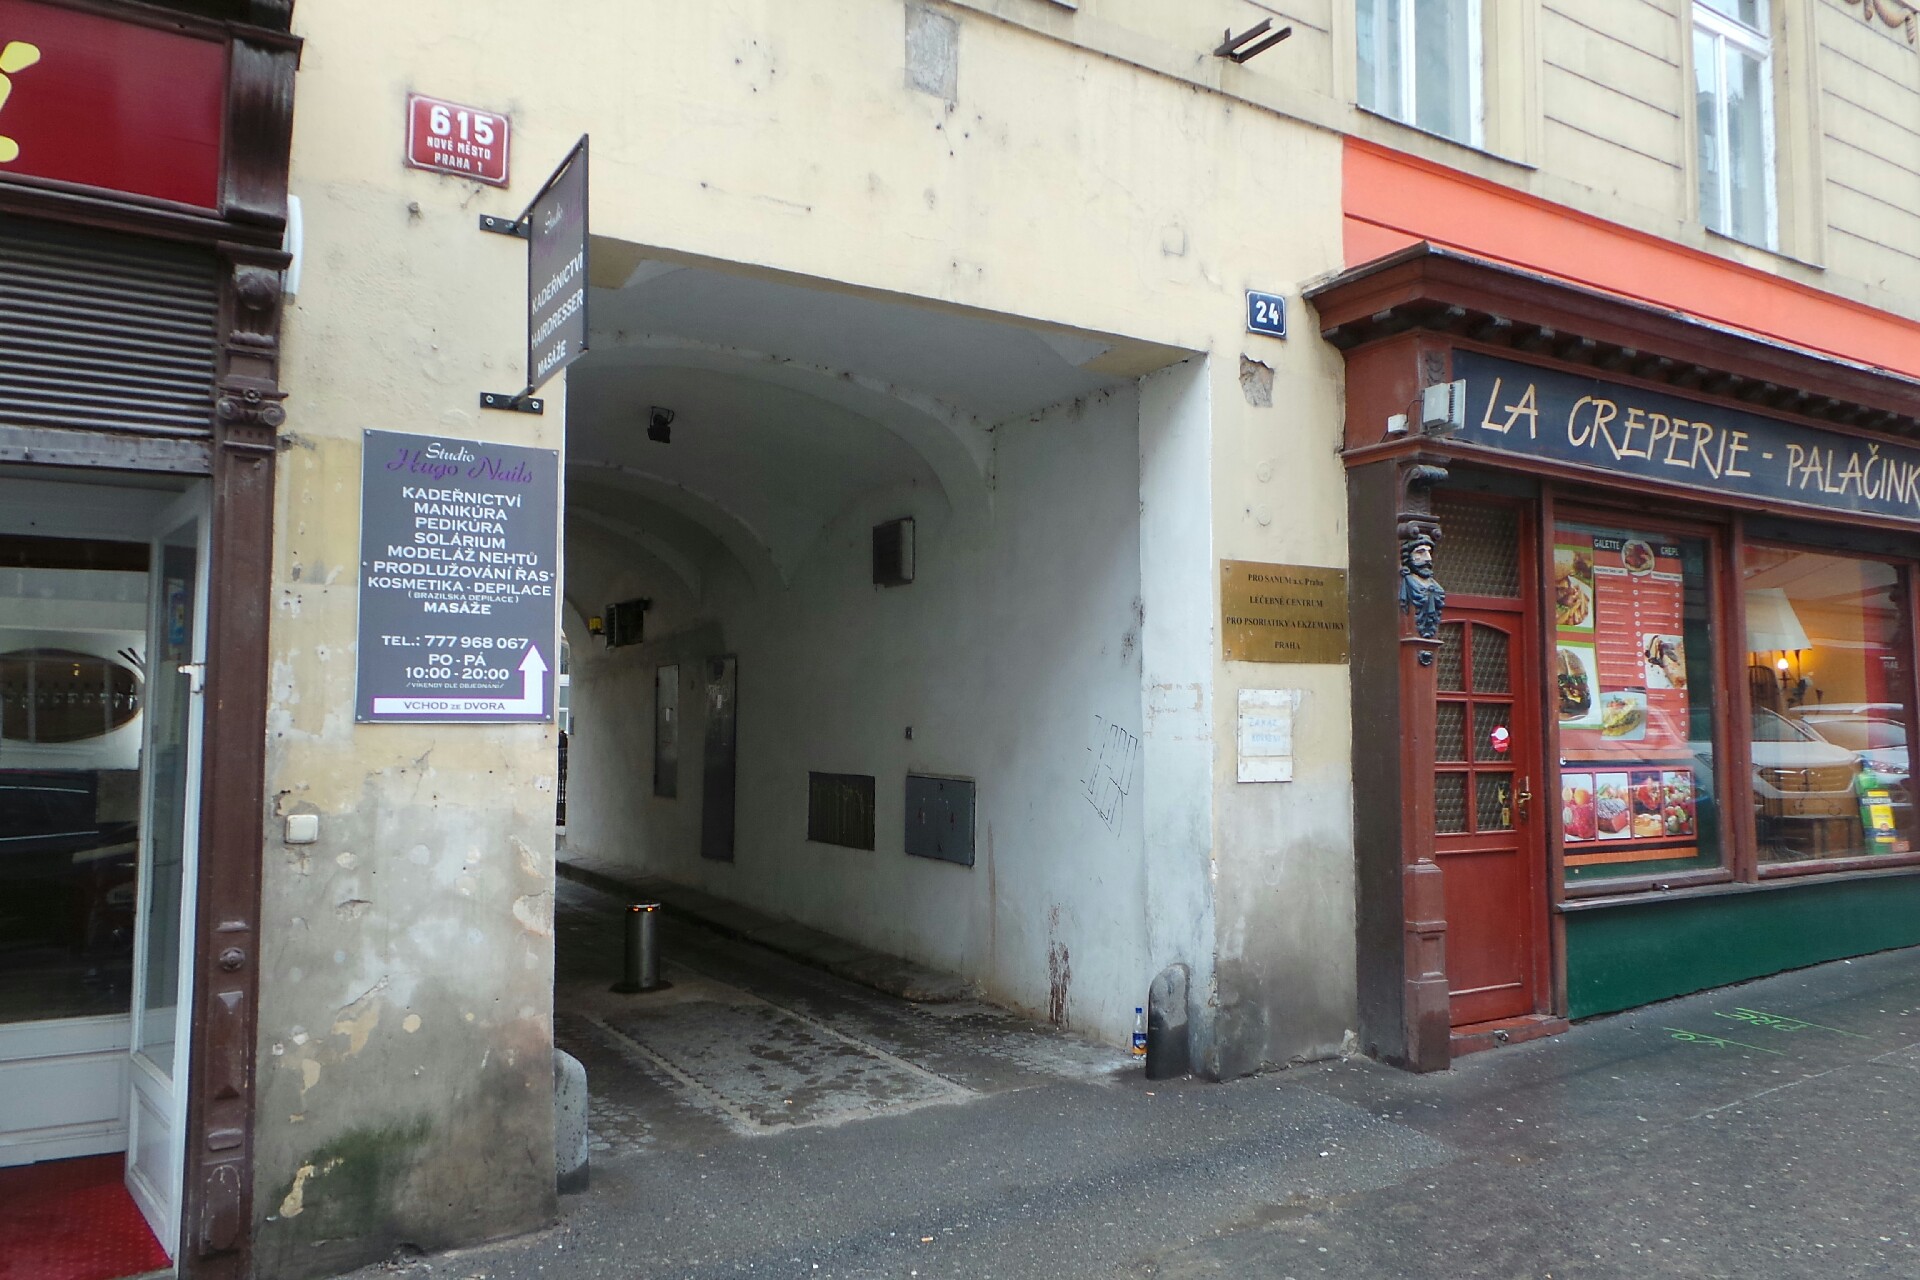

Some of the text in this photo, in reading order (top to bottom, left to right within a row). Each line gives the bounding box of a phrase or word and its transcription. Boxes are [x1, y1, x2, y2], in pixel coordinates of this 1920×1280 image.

[430, 105, 494, 146] 615
[426, 136, 491, 160] NOVÉ MĚSTO
[434, 152, 483, 173] PRAHA 1
[531, 288, 584, 349] HAIRDRESSER
[1255, 300, 1279, 326] 24
[537, 339, 567, 378] MASÁŽE
[1481, 376, 1539, 440] LA
[1566, 395, 1752, 480] CREPERIE
[425, 442, 475, 463] Studio
[384, 449, 534, 484] Hugo Nails
[402, 486, 522, 508] KADEŘNICTVÍ
[414, 502, 508, 521] MANIKÚRA
[415, 517, 505, 534] PEDIKÚRA
[414, 531, 506, 549] SOLÁRIUM
[1594, 538, 1620, 550] GALETTE
[387, 545, 538, 566] MODELÁŽ NEHTŮ
[373, 561, 549, 582] PRODLUŽOVÁNÍ ŘAS
[368, 576, 464, 592] KOSMETIKA
[474, 582, 552, 596] DEPILACE
[1304, 577, 1324, 587] Praha
[423, 601, 492, 615] MASÁŽE
[1249, 595, 1324, 608] LÉČEBNÉ CENTRUM
[1226, 616, 1243, 625] PRO
[1244, 617, 1288, 628] PSORIATIKY
[1297, 620, 1345, 630] EKZEMATIKY
[381, 635, 529, 650] TEL.: 777 968 067
[1274, 641, 1301, 650] PRAHA
[428, 653, 454, 666] PO
[464, 651, 486, 667] PÁ
[405, 666, 451, 679] 10:00
[461, 668, 510, 681] 20:00
[404, 701, 449, 710] VCHOD
[464, 702, 506, 711] DVORA
